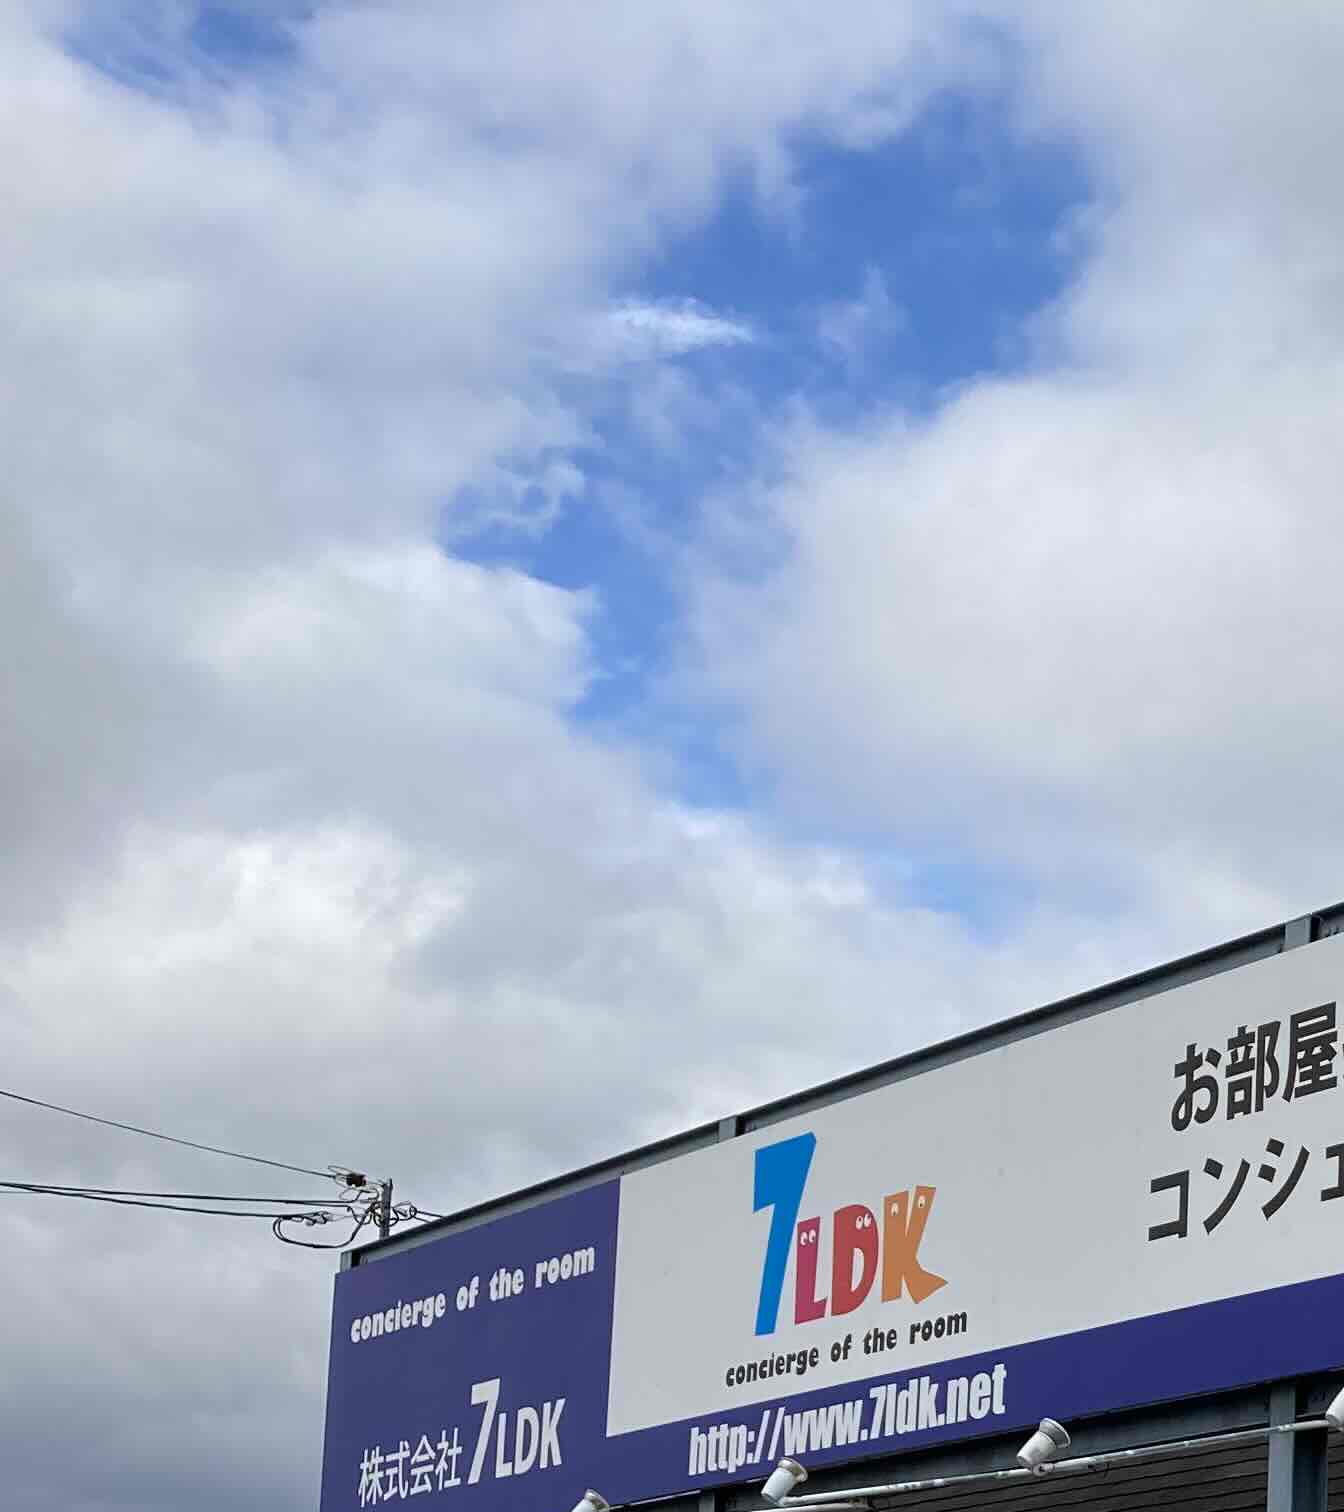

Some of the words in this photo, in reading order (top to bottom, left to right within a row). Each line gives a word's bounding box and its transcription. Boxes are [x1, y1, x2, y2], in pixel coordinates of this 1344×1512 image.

[752, 1130, 950, 1337] 7LDK
[350, 1292, 447, 1344] concierge
[456, 1275, 480, 1312] of
[489, 1267, 525, 1302] the
[535, 1246, 596, 1289] room
[725, 1346, 820, 1388] concierge
[830, 1333, 852, 1363] of
[863, 1327, 898, 1356] the
[909, 1311, 968, 1345] room
[687, 1362, 1008, 1477] http://www.7ldk.net
